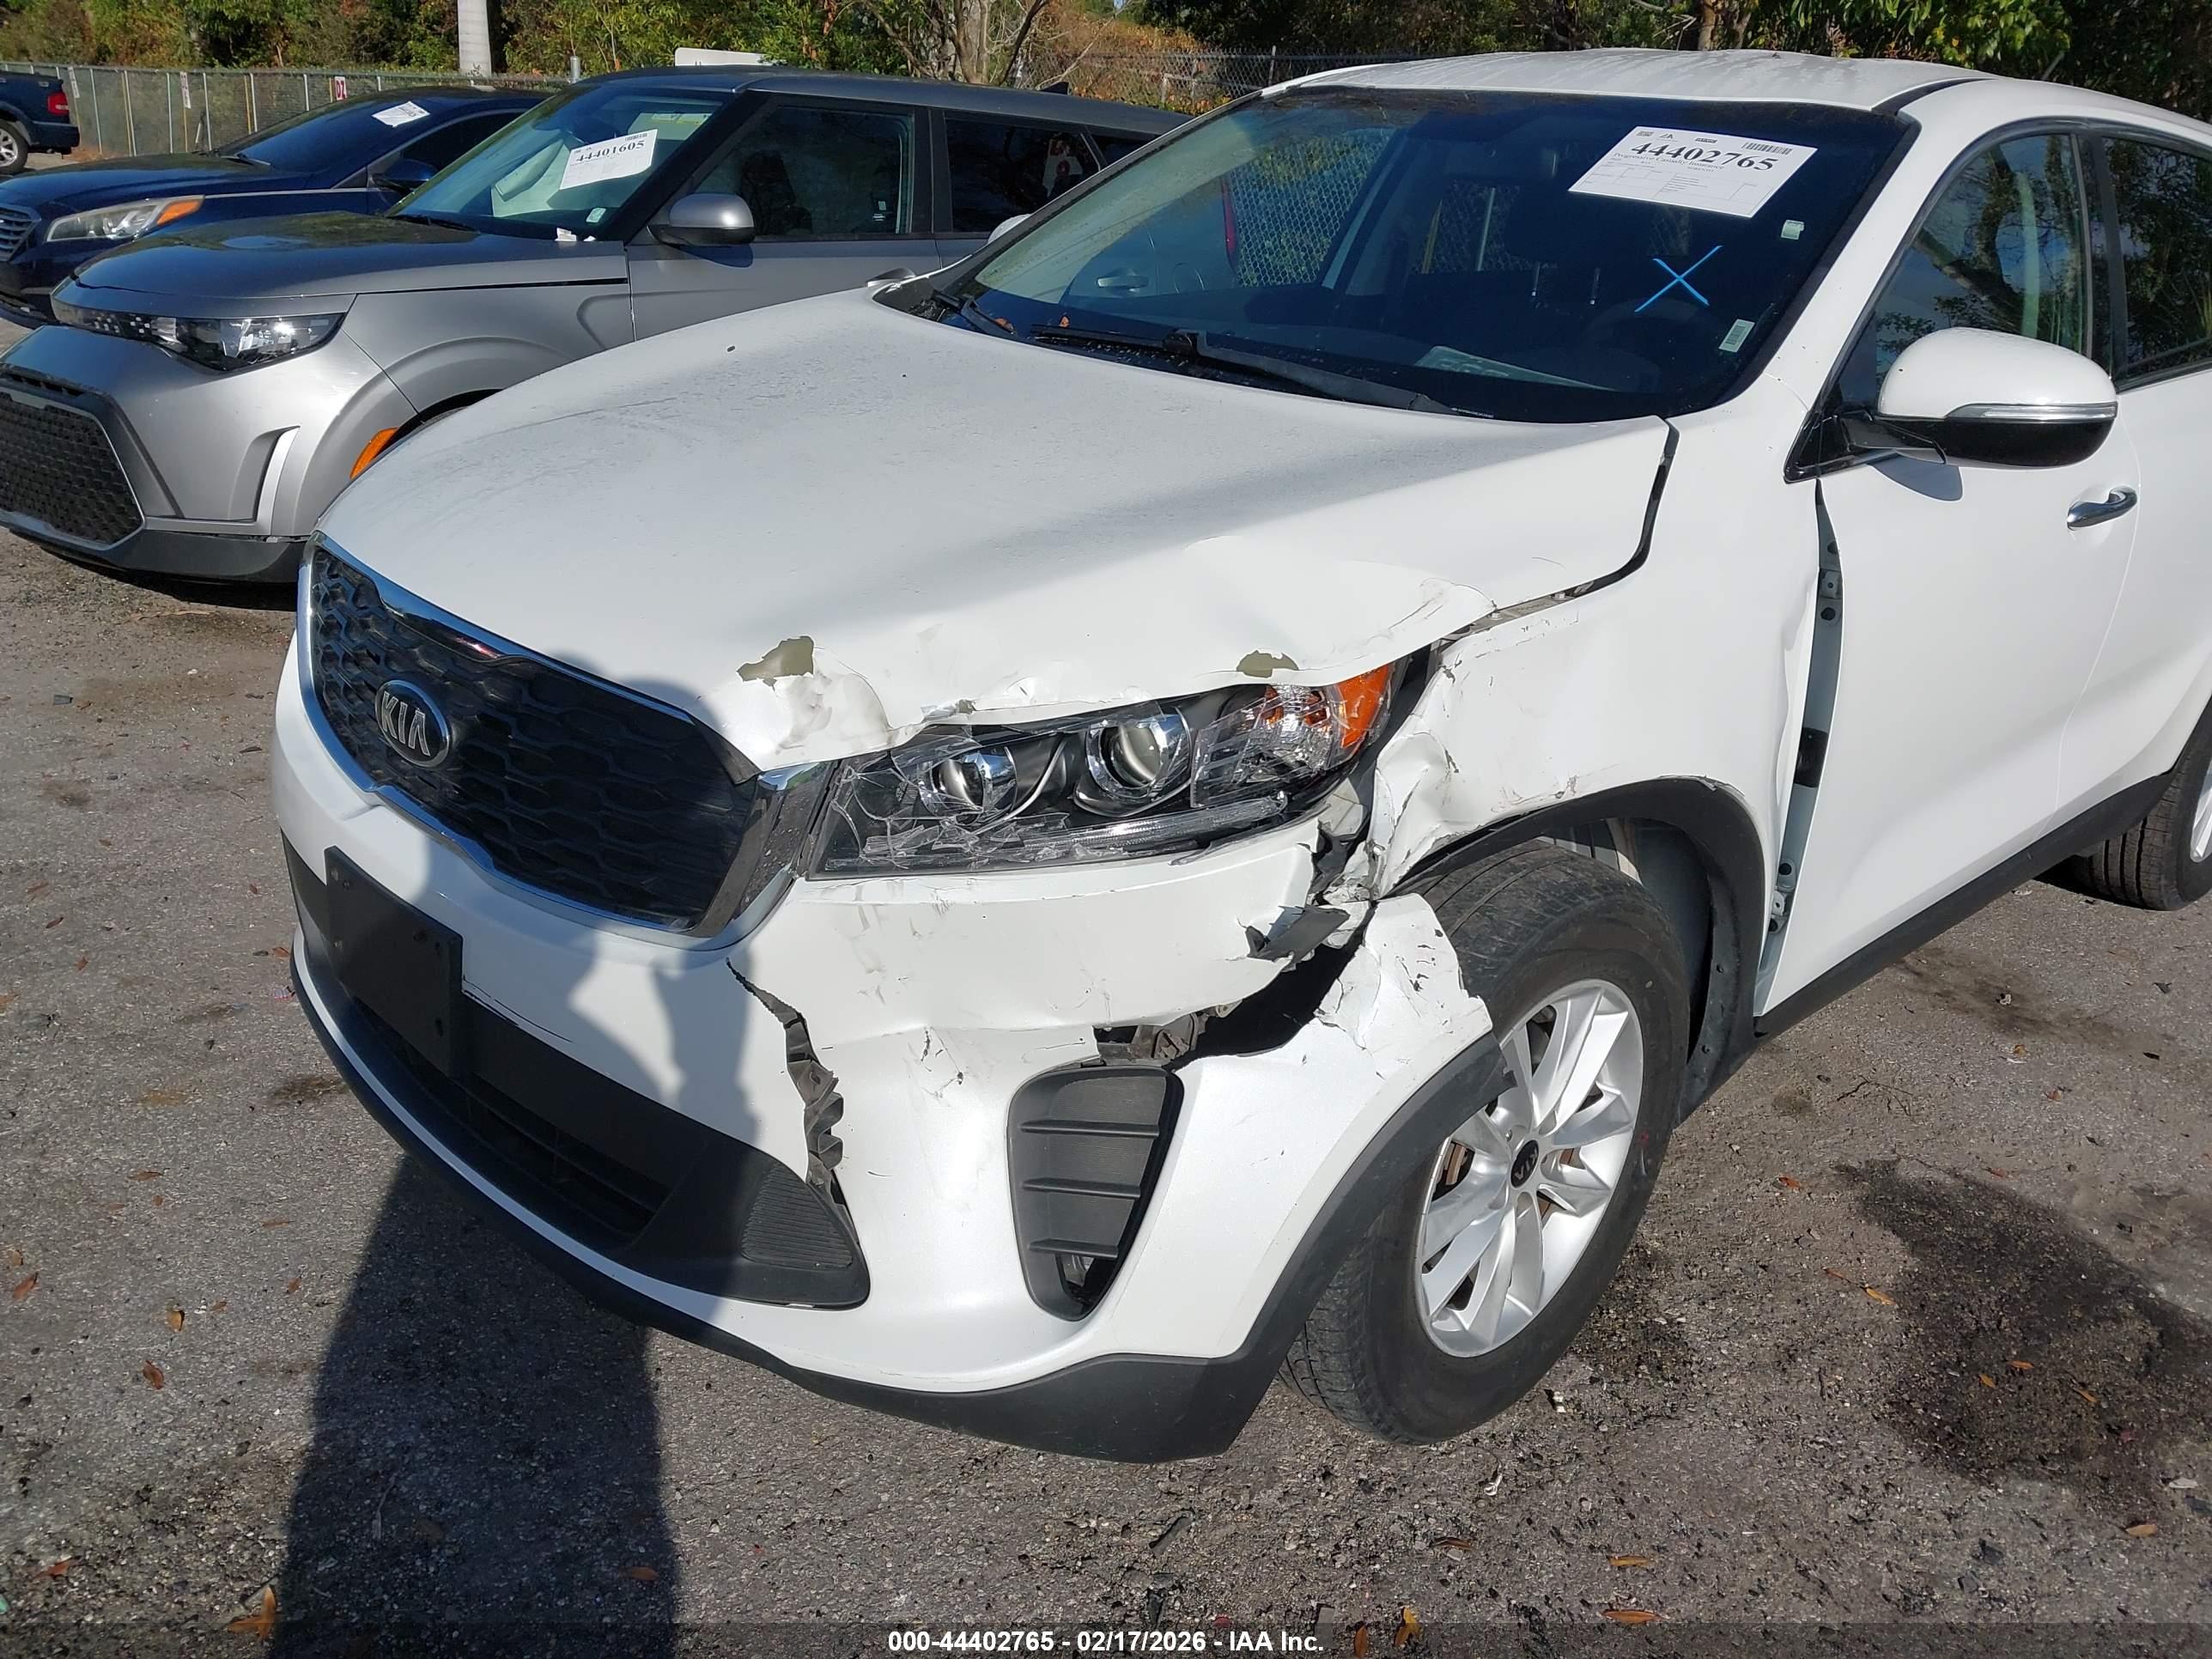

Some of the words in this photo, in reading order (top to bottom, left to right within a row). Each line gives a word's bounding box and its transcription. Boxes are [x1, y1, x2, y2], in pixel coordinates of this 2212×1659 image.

[576, 140, 645, 161] 44401605
[1632, 143, 1779, 171] 44402765
[1656, 157, 1688, 166] Casualty
[1688, 161, 1725, 170] Insurance
[380, 690, 431, 757] KIA
[1514, 1148, 1538, 1181] KIA
